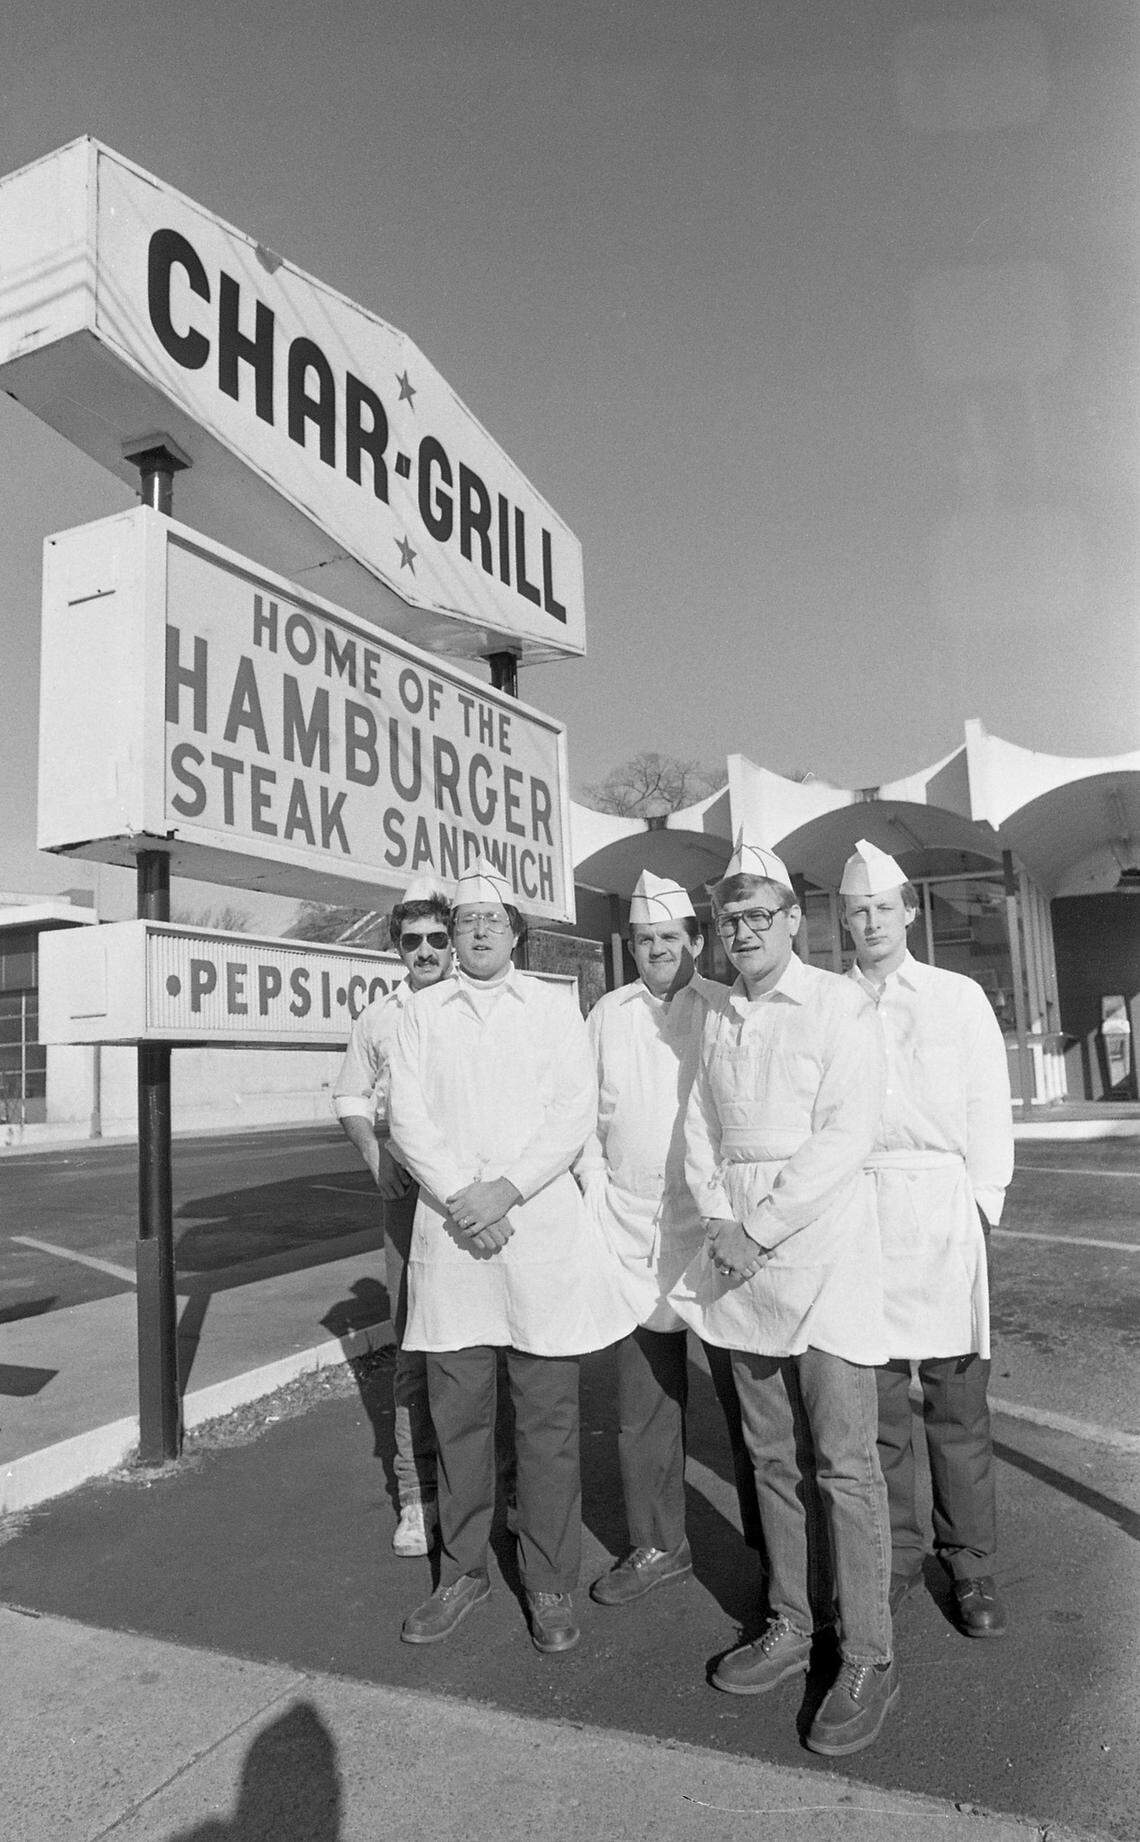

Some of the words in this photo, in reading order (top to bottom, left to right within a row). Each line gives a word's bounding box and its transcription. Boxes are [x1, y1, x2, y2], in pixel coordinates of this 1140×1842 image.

[147, 228, 567, 624] CHAR-GRILL
[165, 624, 553, 846] HAMBURGER
[253, 594, 381, 696] HOME
[398, 668, 443, 721] OF
[458, 694, 511, 754] THE
[170, 743, 350, 854] STEAK
[383, 807, 554, 902] SANDWICH
